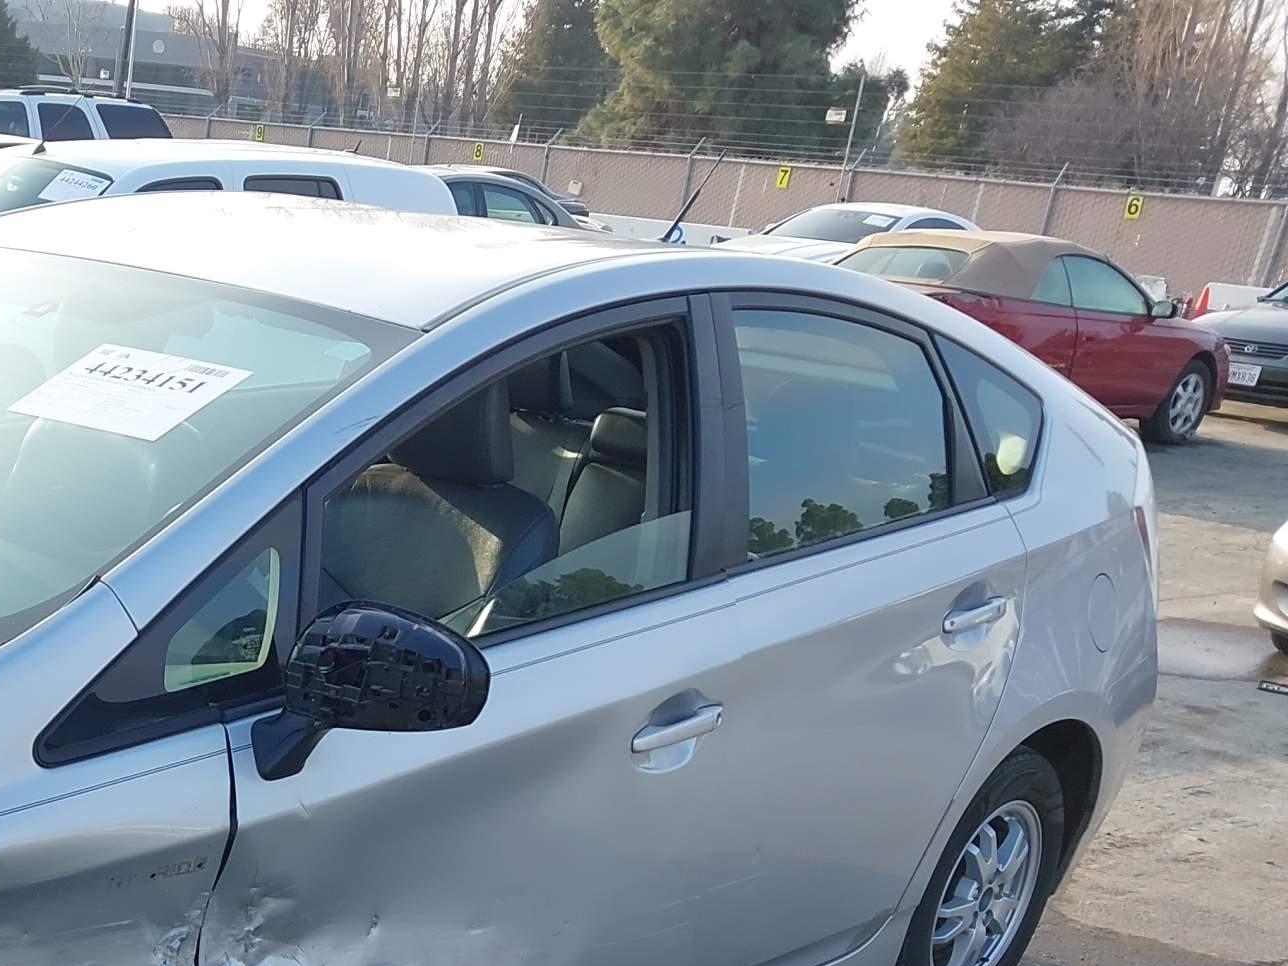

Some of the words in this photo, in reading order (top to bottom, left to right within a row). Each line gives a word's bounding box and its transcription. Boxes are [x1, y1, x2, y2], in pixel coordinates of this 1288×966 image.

[257, 126, 263, 138] 9
[475, 144, 483, 158] 8
[780, 169, 789, 185] 7
[1127, 197, 1141, 215] 6
[84, 361, 208, 394] 44234151
